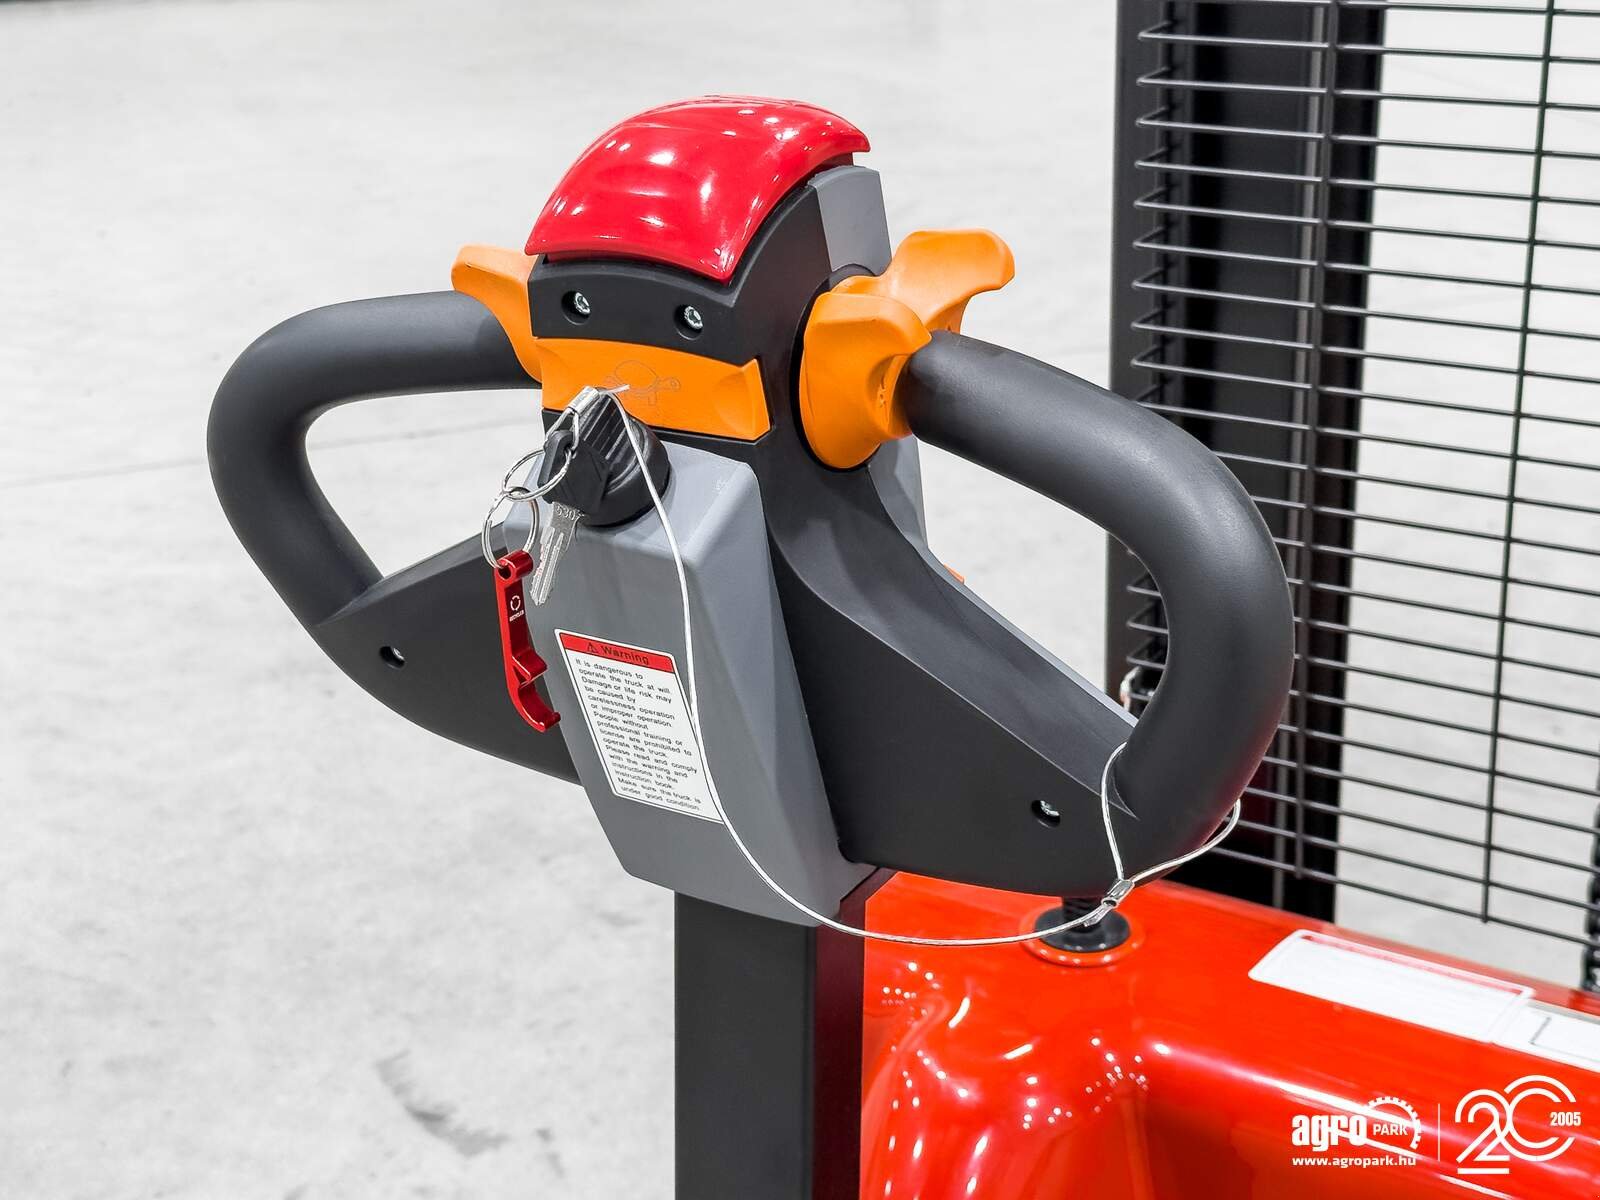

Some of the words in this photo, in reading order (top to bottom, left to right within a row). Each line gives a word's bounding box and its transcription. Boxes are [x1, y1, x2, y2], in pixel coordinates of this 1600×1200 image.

[600, 646, 649, 665] Warning
[579, 669, 606, 679] operate
[609, 675, 621, 683] the
[624, 679, 643, 688] truck
[593, 663, 632, 677] dangerous
[581, 676, 612, 689] Damage
[656, 695, 671, 704] may
[597, 689, 623, 700] caused
[626, 695, 635, 703] by
[588, 695, 636, 711] carelessness
[639, 707, 675, 720] operation
[602, 706, 633, 717] improper
[593, 711, 618, 722] People
[622, 720, 648, 730] without
[597, 721, 640, 735] professional
[643, 731, 672, 744] training
[603, 738, 630, 748] operate
[605, 744, 630, 756] Please
[633, 753, 650, 761] read
[641, 763, 670, 775] warning
[673, 792, 691, 801] truck
